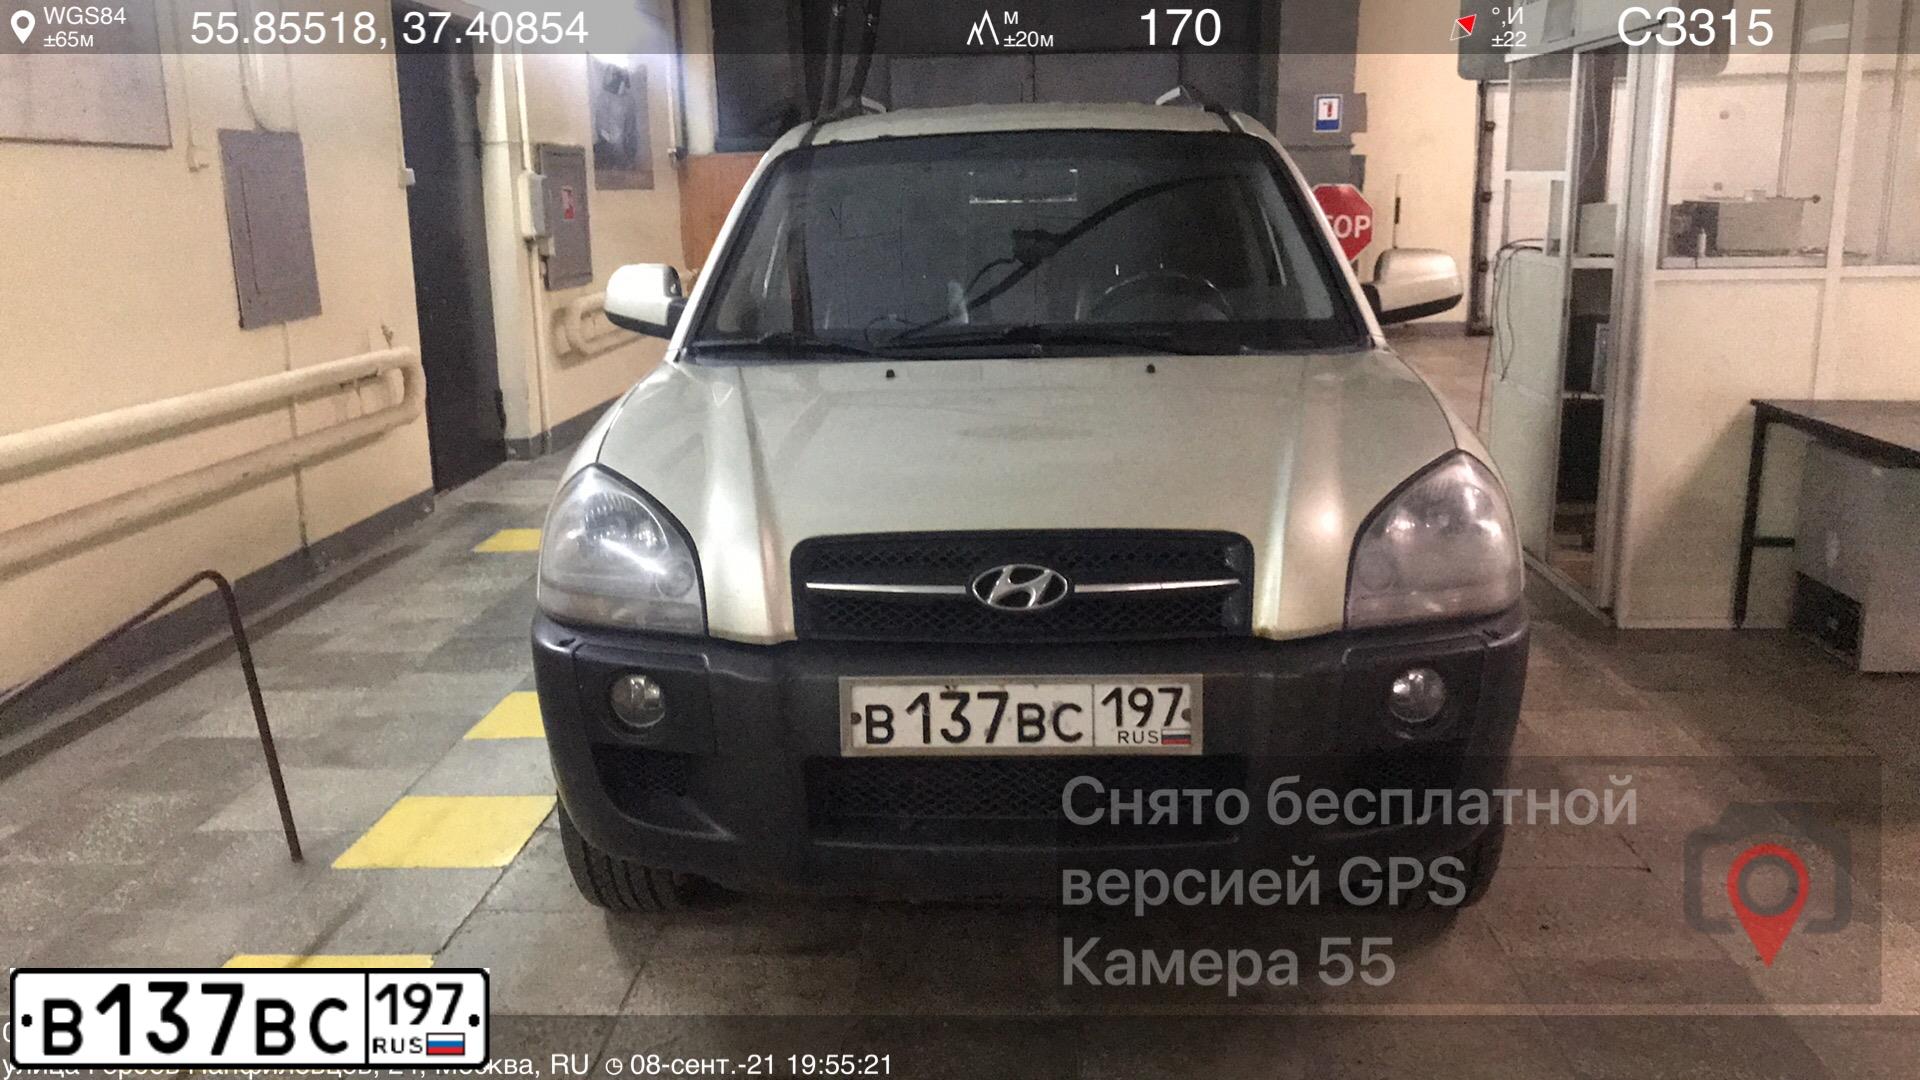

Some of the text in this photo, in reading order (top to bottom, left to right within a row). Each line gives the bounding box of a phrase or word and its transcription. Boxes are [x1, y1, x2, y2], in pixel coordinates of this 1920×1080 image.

[1326, 214, 1371, 239] OP
[1101, 687, 1183, 727] 197
[1117, 730, 1159, 744] RUS
